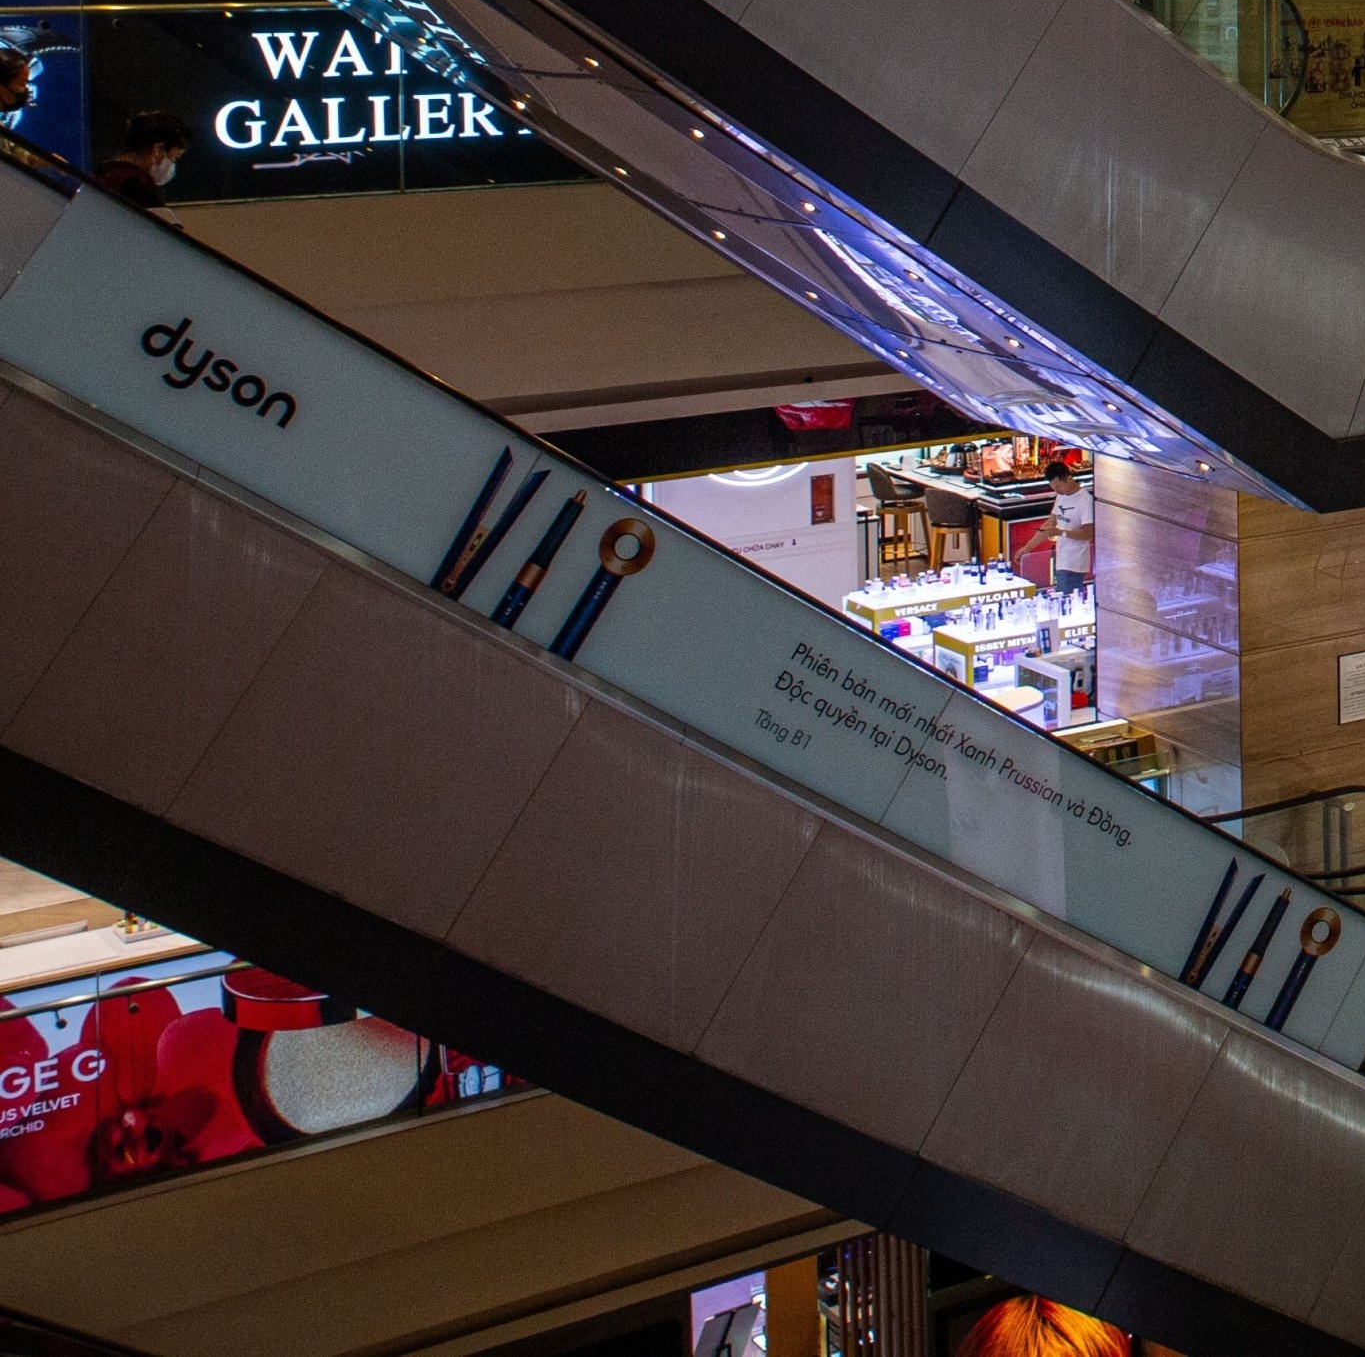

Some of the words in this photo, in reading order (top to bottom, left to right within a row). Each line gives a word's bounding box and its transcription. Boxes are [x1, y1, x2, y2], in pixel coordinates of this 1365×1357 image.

[251, 29, 408, 80] WAT
[213, 92, 534, 149] GALLER
[141, 317, 297, 429] dyson
[894, 602, 940, 617] VERSACE
[975, 639, 1006, 653] ISSEY
[1064, 627, 1089, 639] ELIE
[754, 708, 790, 744] Tầng
[791, 729, 812, 750] B1
[774, 669, 814, 703] Độc
[813, 697, 868, 735] quyền
[869, 723, 896, 749] tại
[893, 735, 948, 781] Dyson.
[791, 642, 839, 683] Phiên
[841, 669, 877, 704] bản
[878, 695, 917, 724] mới
[914, 715, 955, 745] nhất
[954, 733, 998, 770] Xanh
[998, 757, 1064, 808] Prussian
[1066, 798, 1086, 819] và
[1086, 806, 1132, 847] Đồng.
[71, 1049, 107, 1082] G
[20, 1093, 81, 1119] VELVET
